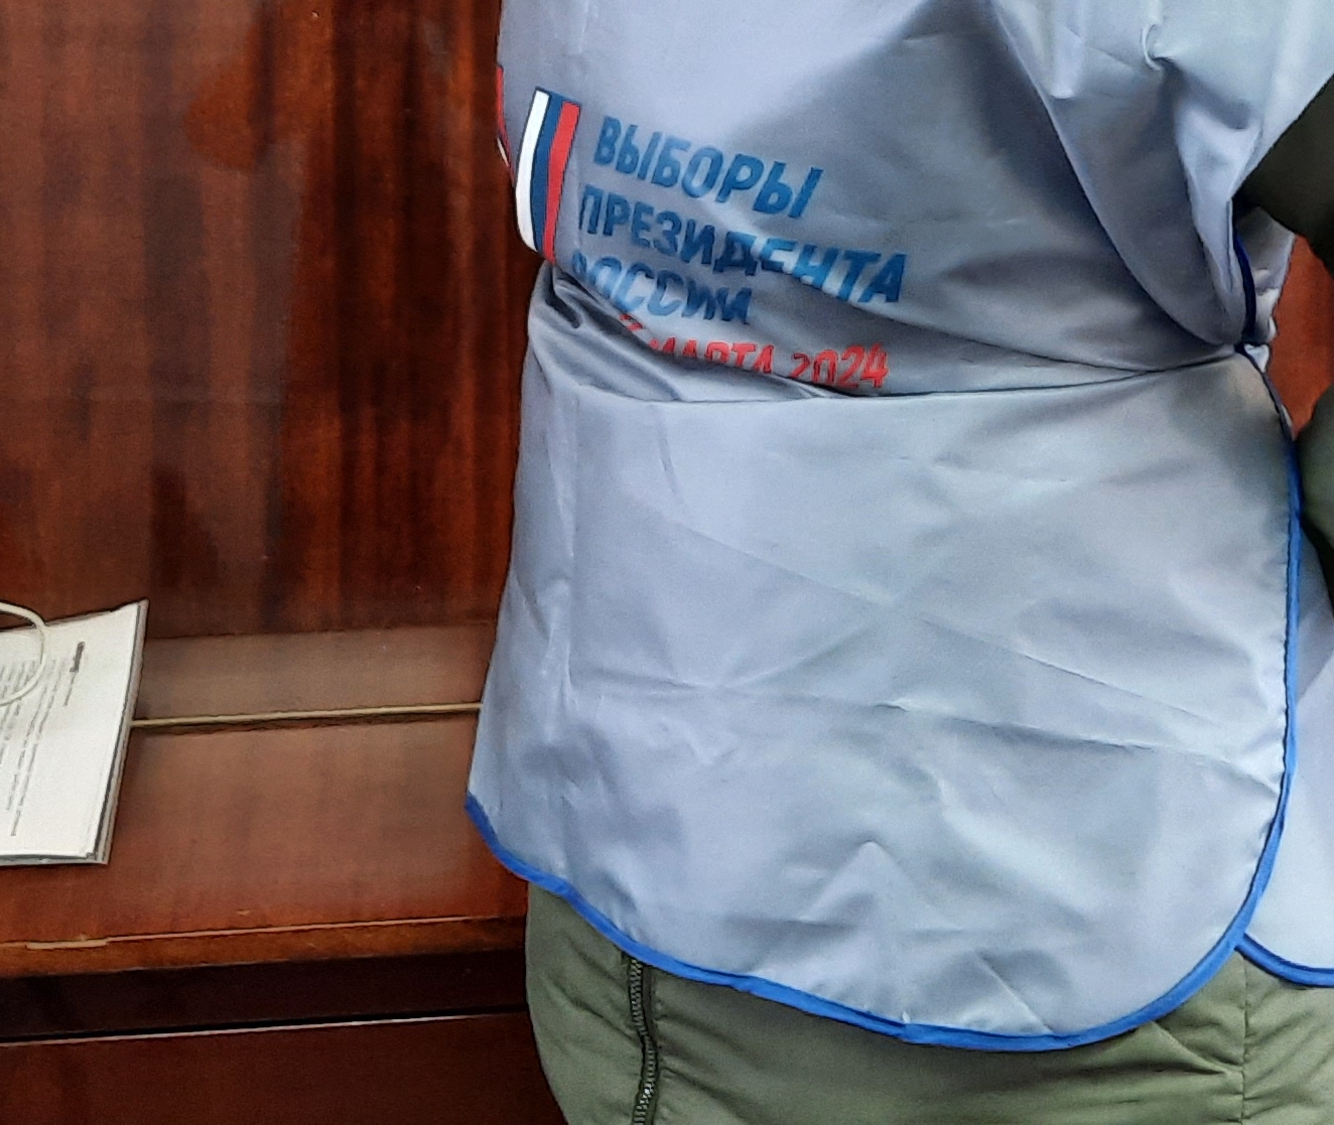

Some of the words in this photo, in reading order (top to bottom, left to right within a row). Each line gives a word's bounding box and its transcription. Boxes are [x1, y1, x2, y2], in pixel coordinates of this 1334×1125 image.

[593, 114, 824, 220] ВЫБОРЫ
[577, 184, 909, 304] ПРЕЗИДЕНТА
[789, 341, 890, 389] 2024
